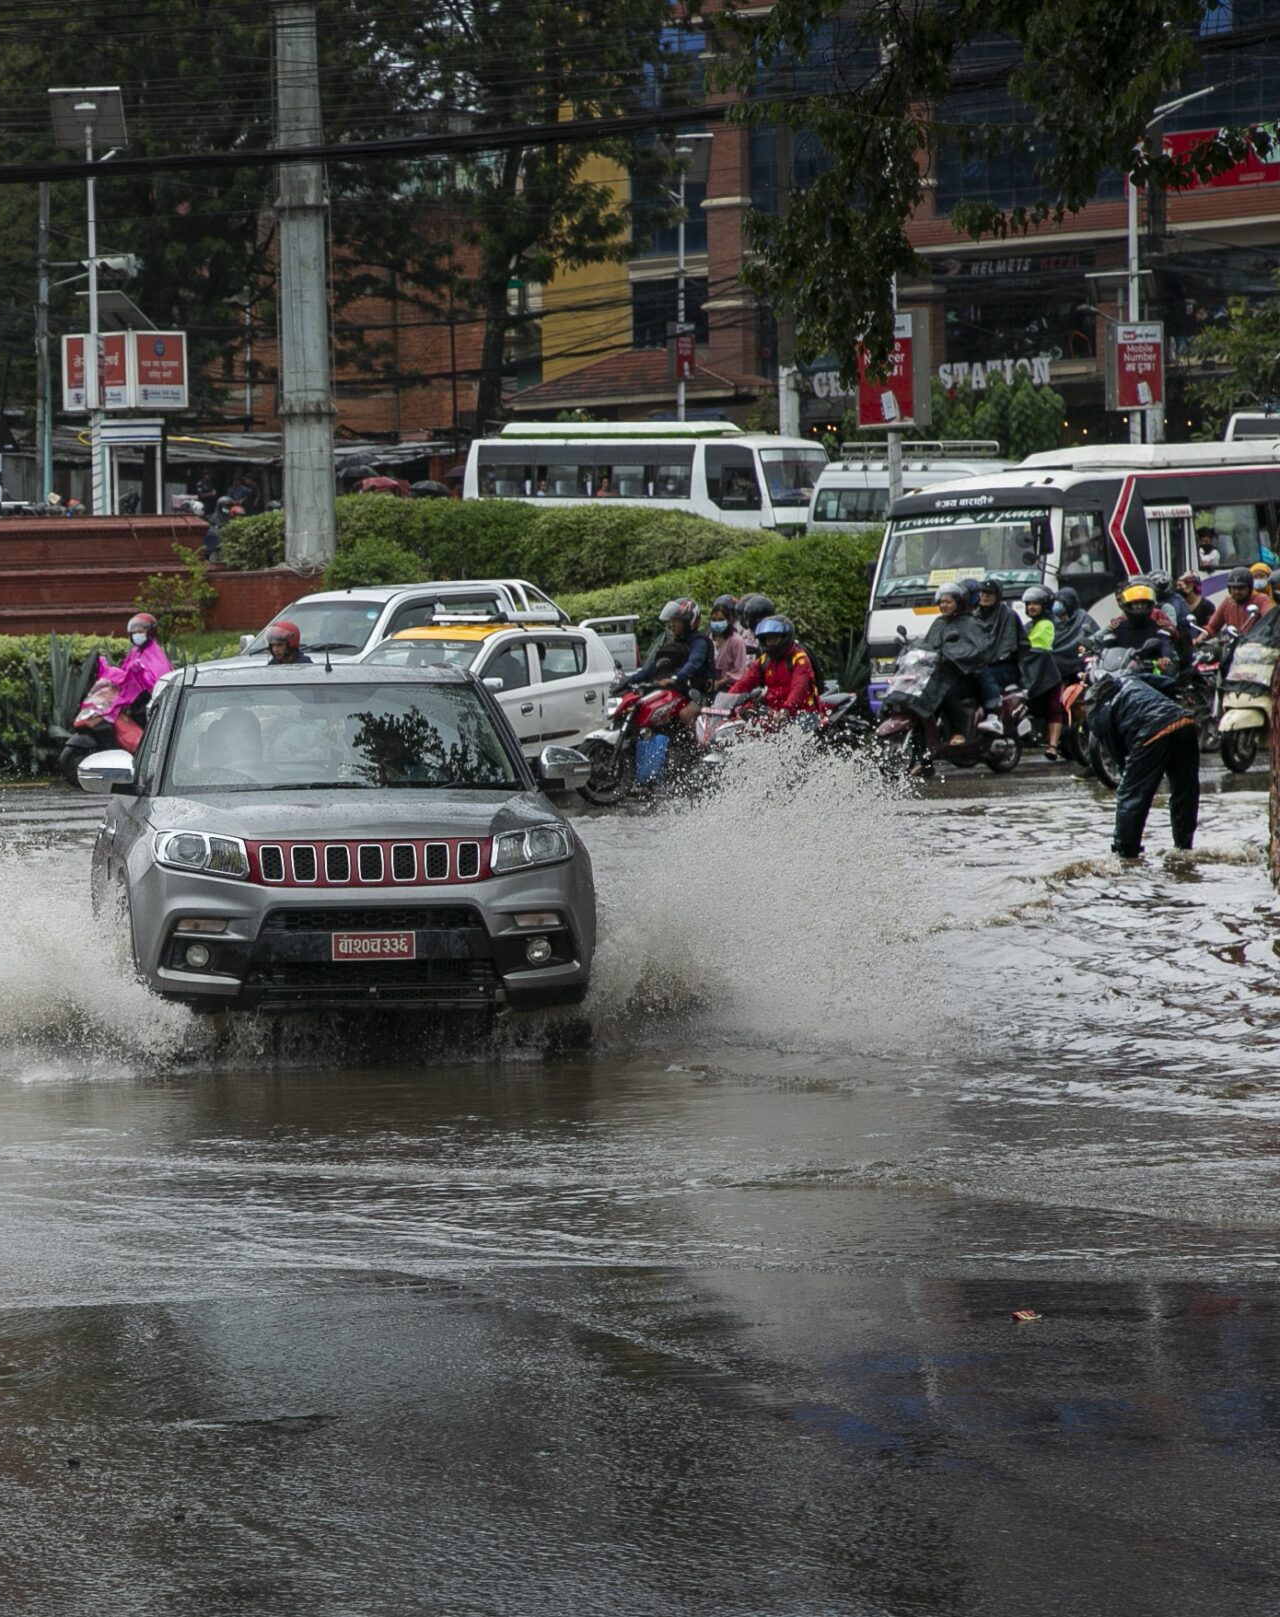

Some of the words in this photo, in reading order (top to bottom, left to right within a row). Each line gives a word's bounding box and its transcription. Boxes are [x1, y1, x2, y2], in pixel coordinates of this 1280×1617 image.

[971, 258, 1032, 275] HELMETS
[1126, 343, 1154, 352] Mobile
[1123, 353, 1157, 362] Number
[942, 498, 957, 508] जय
